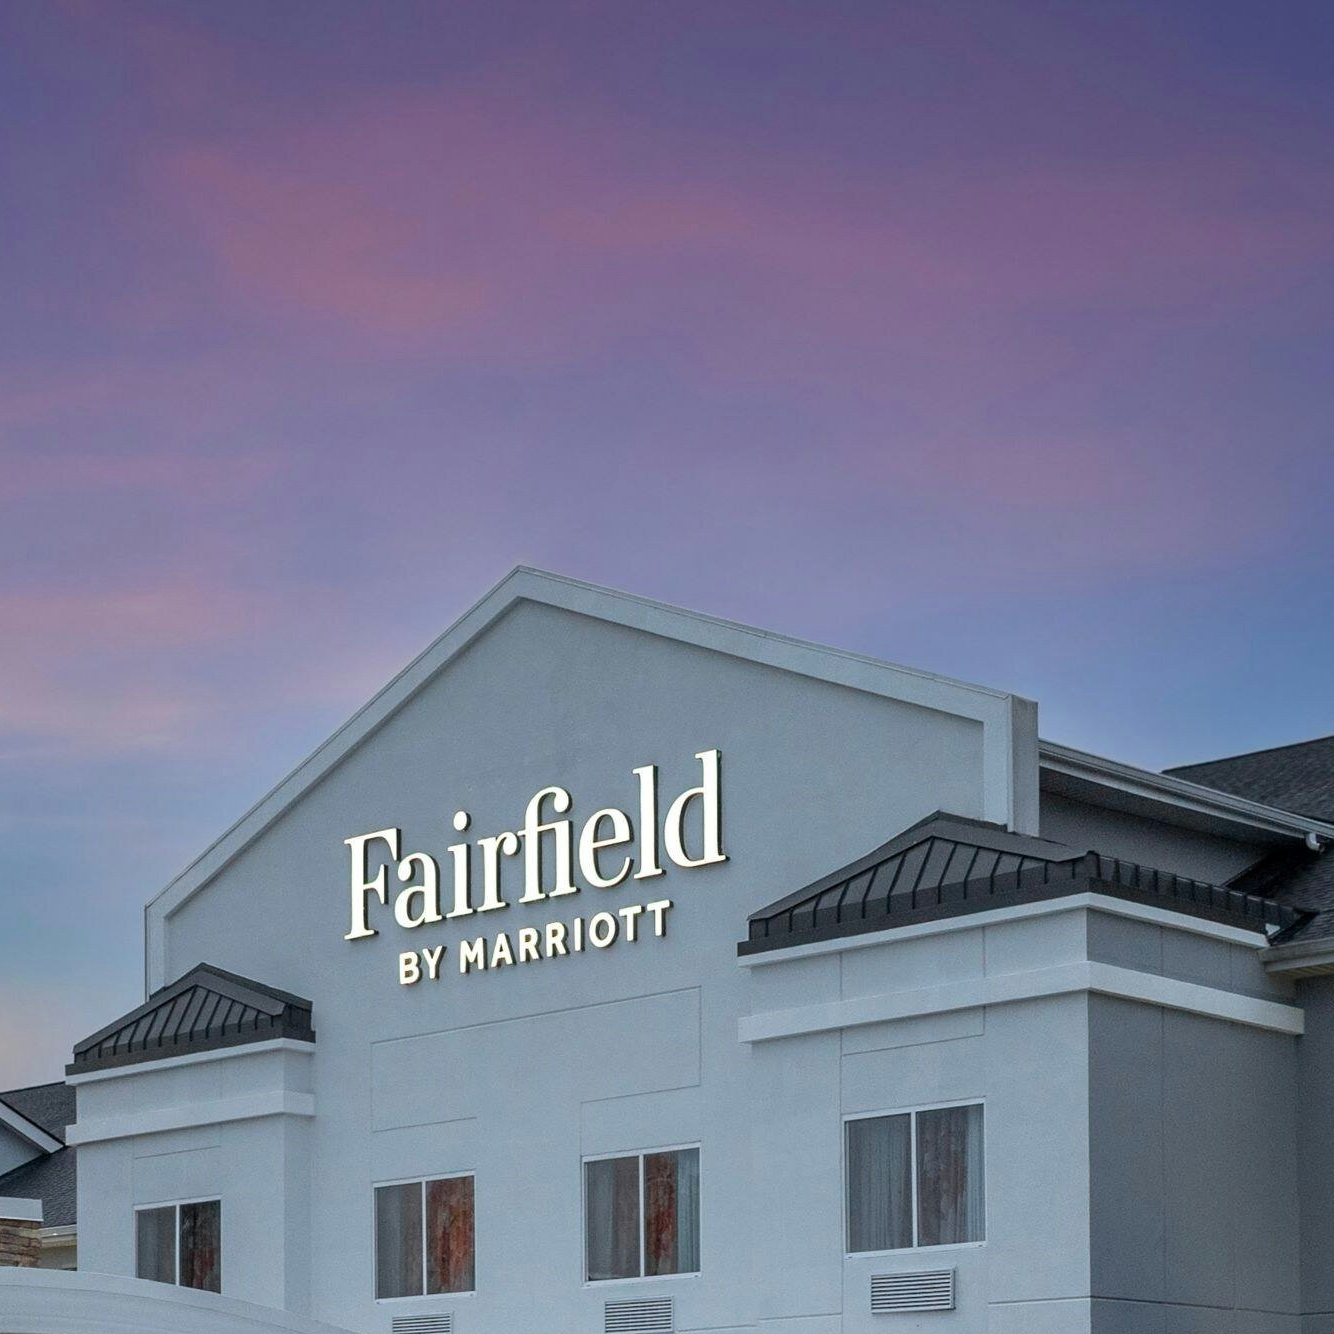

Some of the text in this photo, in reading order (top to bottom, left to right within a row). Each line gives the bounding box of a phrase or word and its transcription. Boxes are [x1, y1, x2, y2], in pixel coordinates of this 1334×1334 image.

[343, 748, 728, 941] Fairfield
[398, 899, 672, 985] BY MARRIOTT
